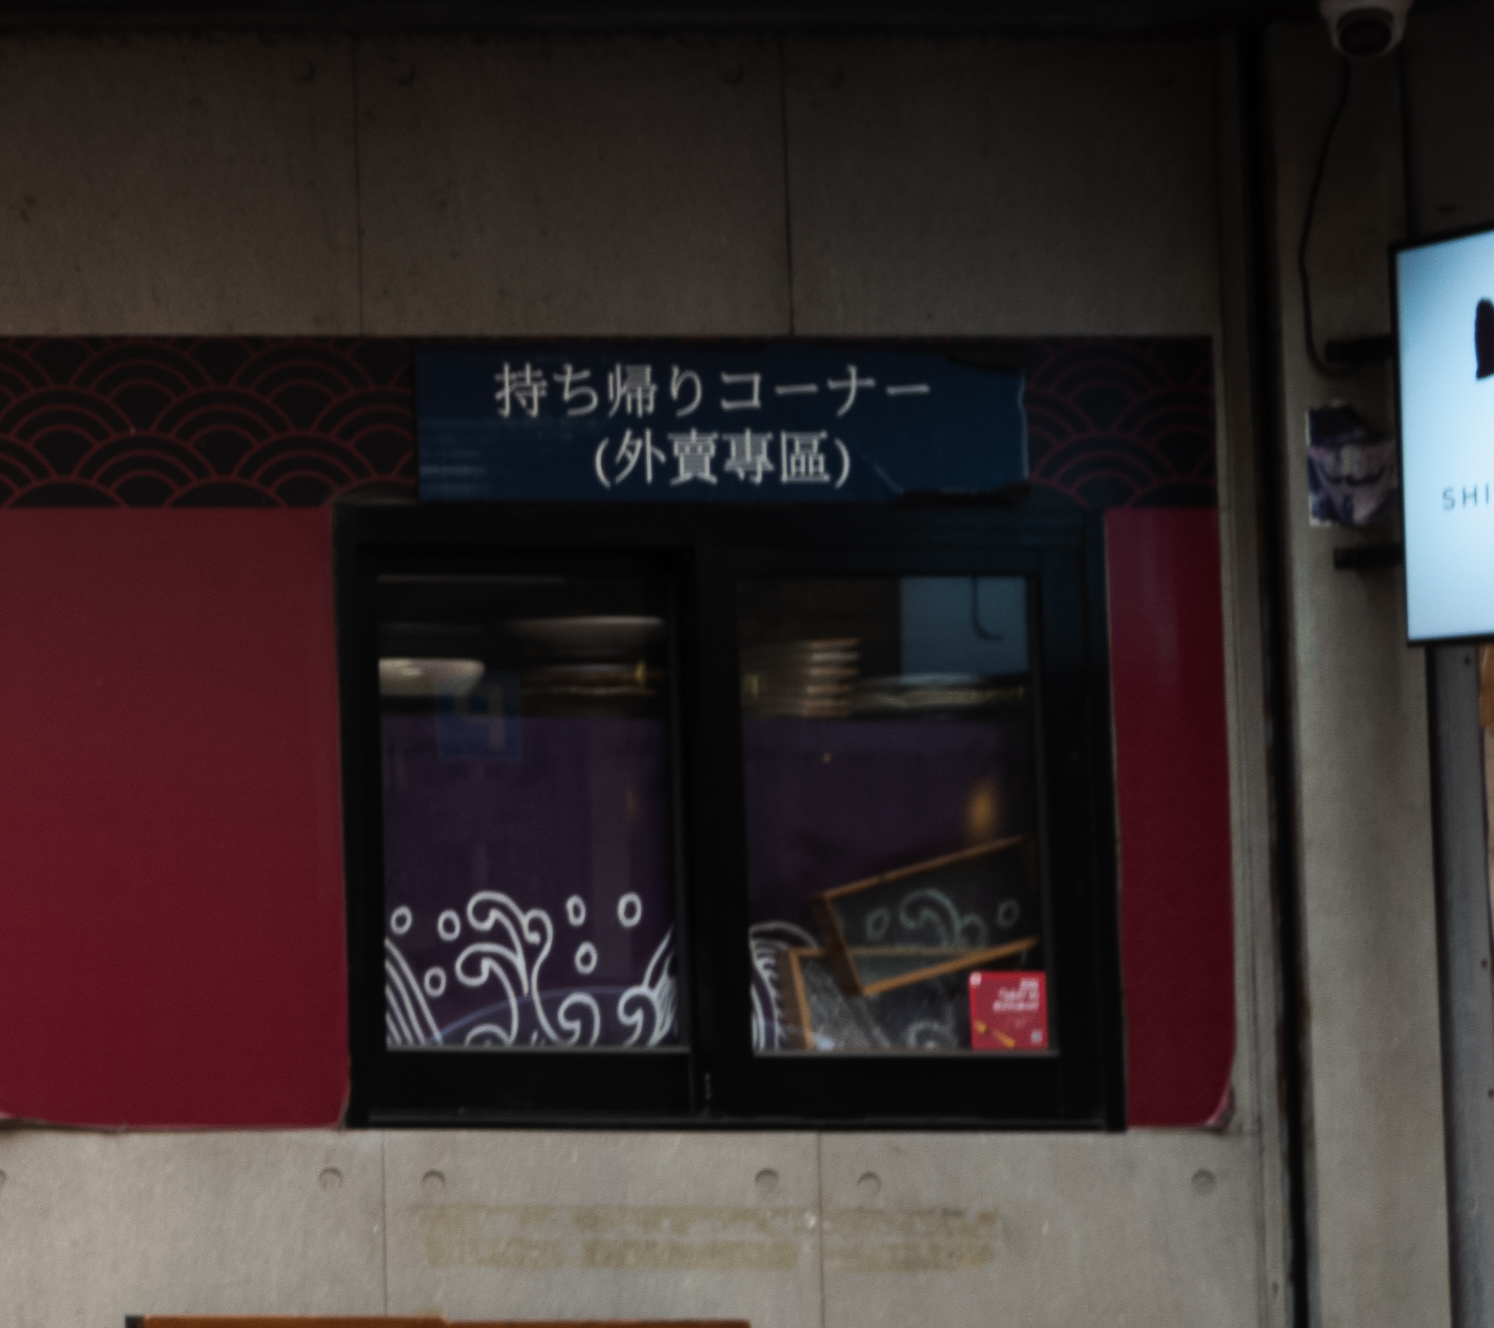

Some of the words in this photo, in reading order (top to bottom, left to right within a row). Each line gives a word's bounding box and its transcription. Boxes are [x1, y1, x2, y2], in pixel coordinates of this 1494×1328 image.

[494, 362, 931, 419] 持ち帰りコーナー
[594, 427, 851, 490] (外賣專區)
